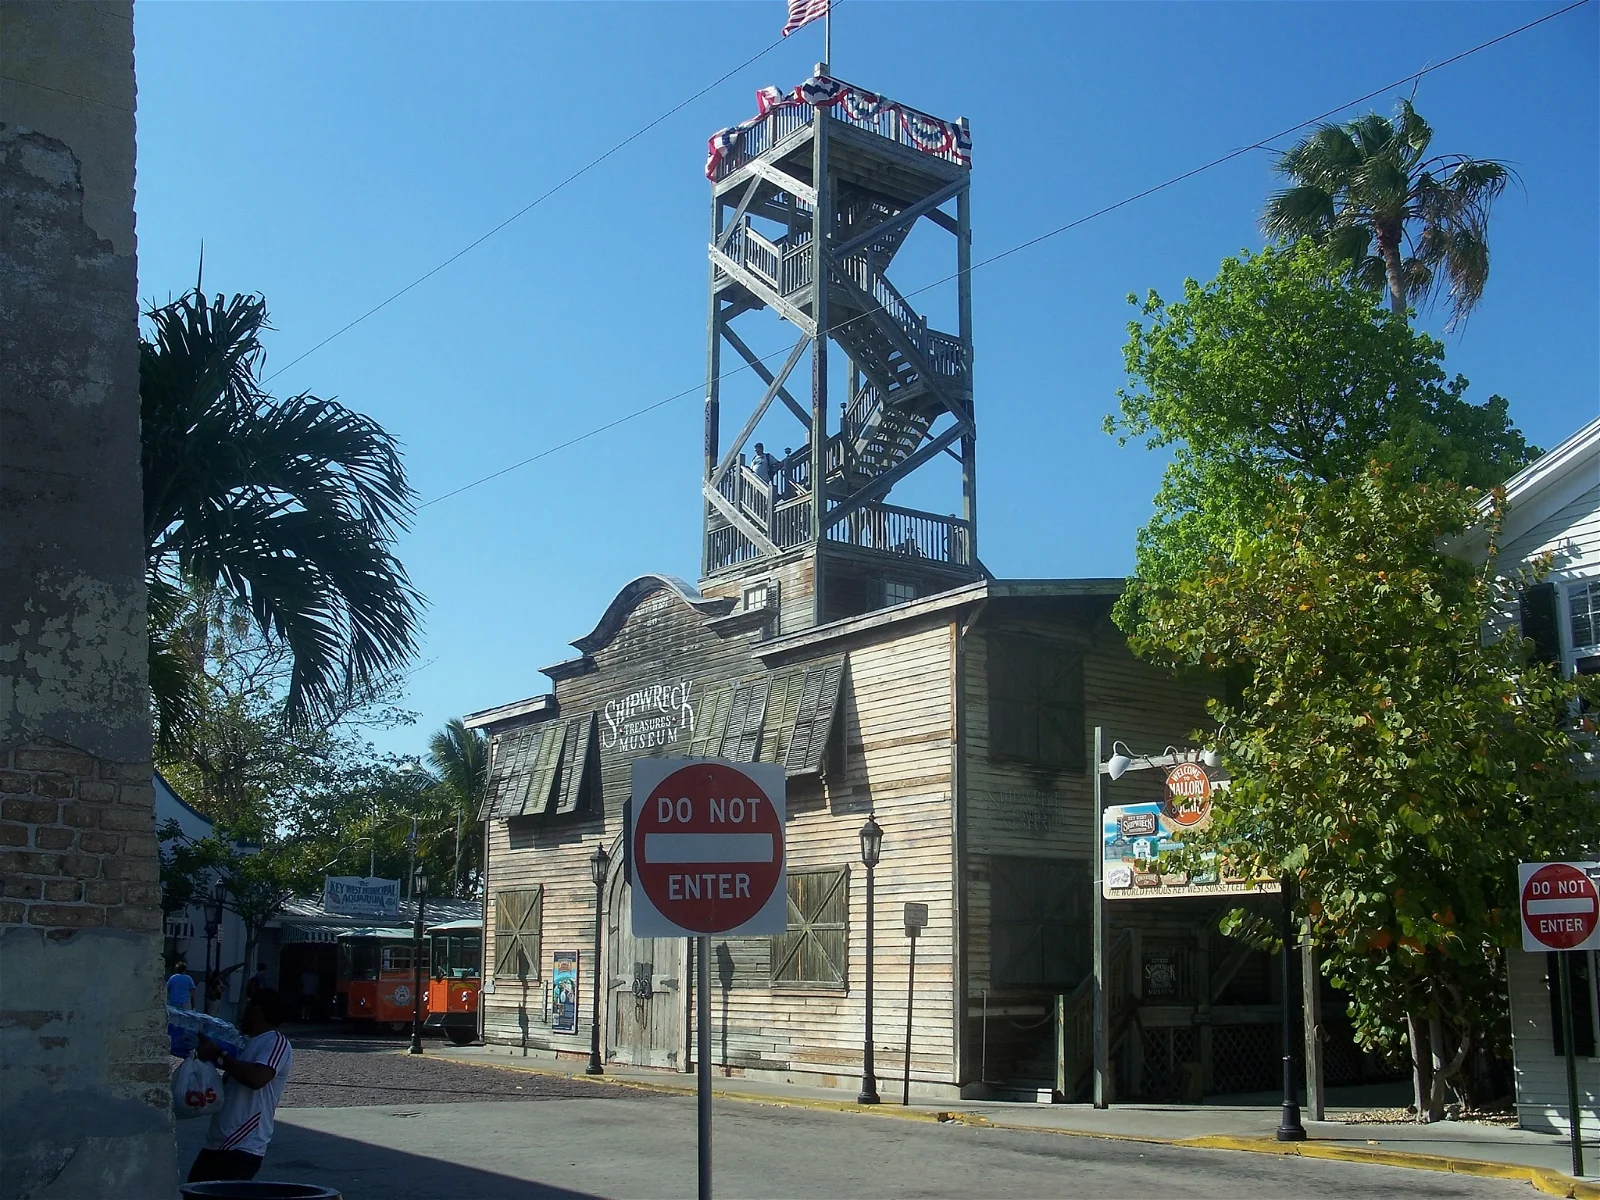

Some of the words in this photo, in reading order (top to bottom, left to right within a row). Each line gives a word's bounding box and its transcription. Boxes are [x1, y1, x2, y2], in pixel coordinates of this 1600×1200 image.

[602, 681, 694, 748] SHIPWRECK
[623, 715, 672, 736] TREASURES
[619, 727, 678, 752] MUSEUM
[1171, 765, 1202, 782] WELCOME
[1169, 779, 1205, 798] MALLORY
[657, 797, 692, 823] DO
[709, 798, 761, 823] NOT
[330, 881, 345, 894] KEY
[346, 884, 361, 895] WEST
[668, 873, 751, 900] ENTER
[1108, 888, 1120, 897] THE
[1121, 887, 1144, 897] WORLD
[1145, 885, 1171, 896] FAMOUS
[1187, 883, 1204, 894] WEST
[1205, 882, 1230, 893] SUNSET
[1532, 881, 1550, 895] DO
[1558, 880, 1585, 894] NOT
[341, 894, 386, 908] AQUARIUM
[1540, 918, 1584, 934] ENTER
